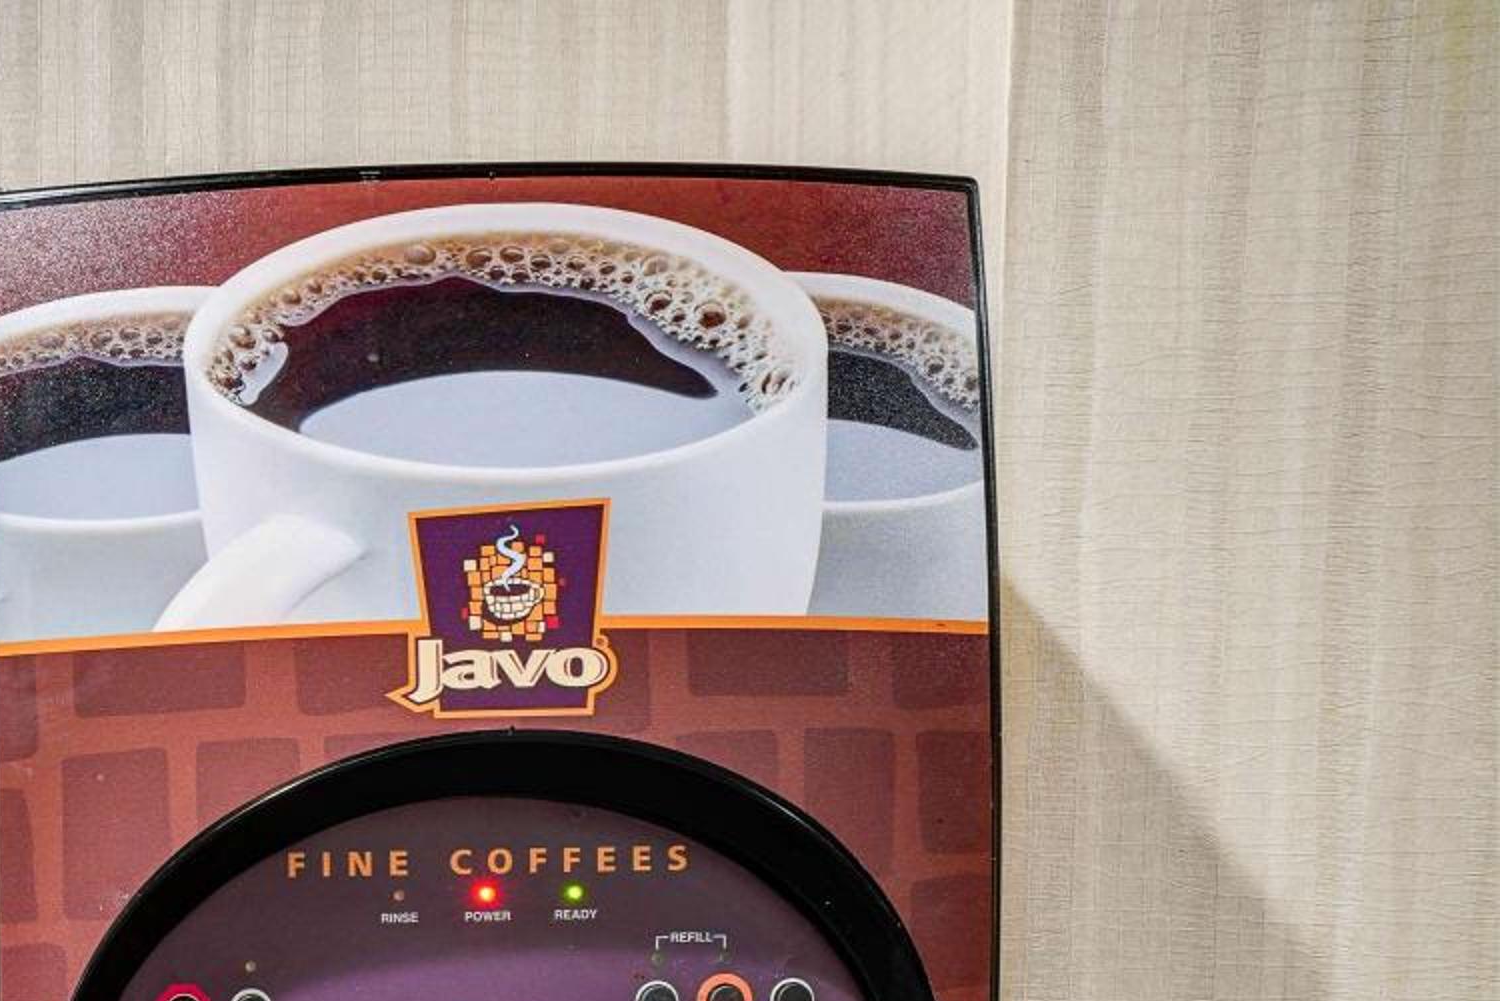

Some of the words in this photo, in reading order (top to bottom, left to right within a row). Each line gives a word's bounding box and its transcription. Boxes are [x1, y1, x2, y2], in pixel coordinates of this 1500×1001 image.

[408, 639, 607, 703] Javo
[287, 850, 410, 878] FINE
[450, 845, 690, 875] COFFEES
[381, 912, 419, 923] RINSE
[464, 911, 511, 922] POWER
[554, 909, 598, 920] READY
[670, 932, 713, 943] REFILL
